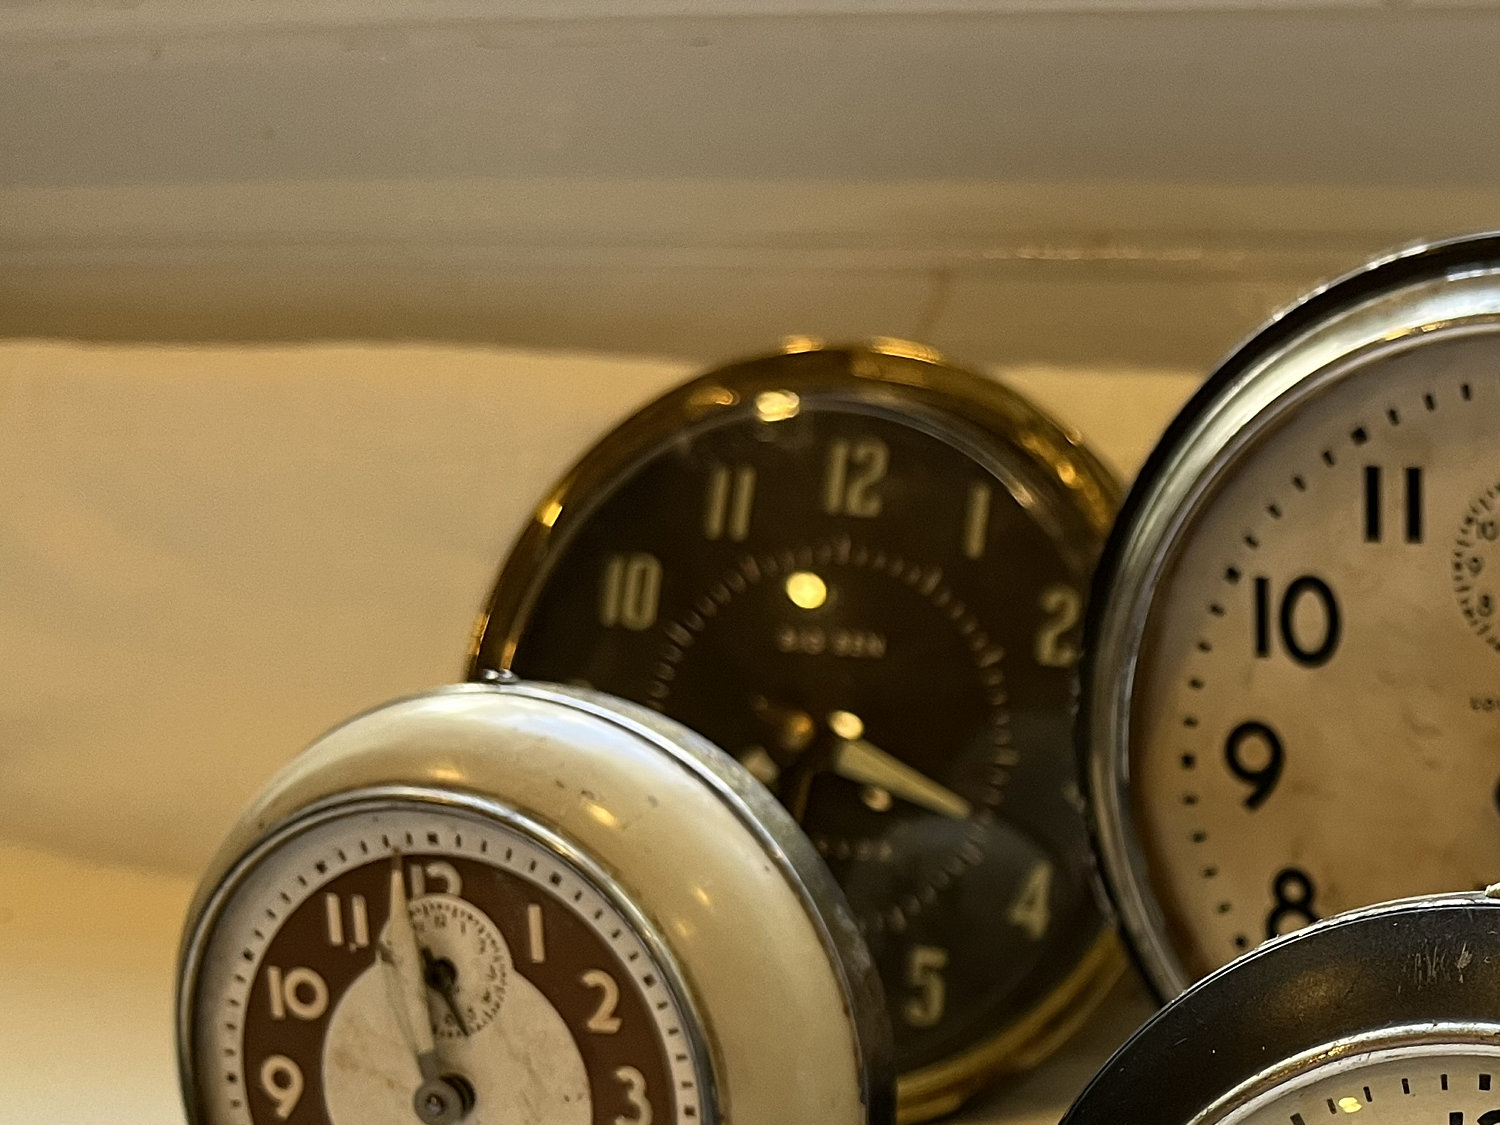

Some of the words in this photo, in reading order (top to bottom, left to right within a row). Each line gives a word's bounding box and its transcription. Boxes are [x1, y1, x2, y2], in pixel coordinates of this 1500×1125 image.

[706, 464, 755, 541] 11
[826, 436, 889, 517] 12
[1363, 465, 1422, 545] 11
[964, 482, 989, 559] 1
[603, 552, 663, 630] 10
[1034, 583, 1080, 668] 2
[1253, 574, 1342, 667] 10
[1224, 720, 1286, 812] 9
[326, 893, 370, 947] 11
[528, 903, 546, 963] 1
[1008, 861, 1053, 941] 4
[1265, 867, 1323, 939] 8
[267, 965, 329, 1021] 10
[580, 970, 622, 1034] 2
[906, 947, 948, 1026] 5
[260, 1054, 304, 1119] 9
